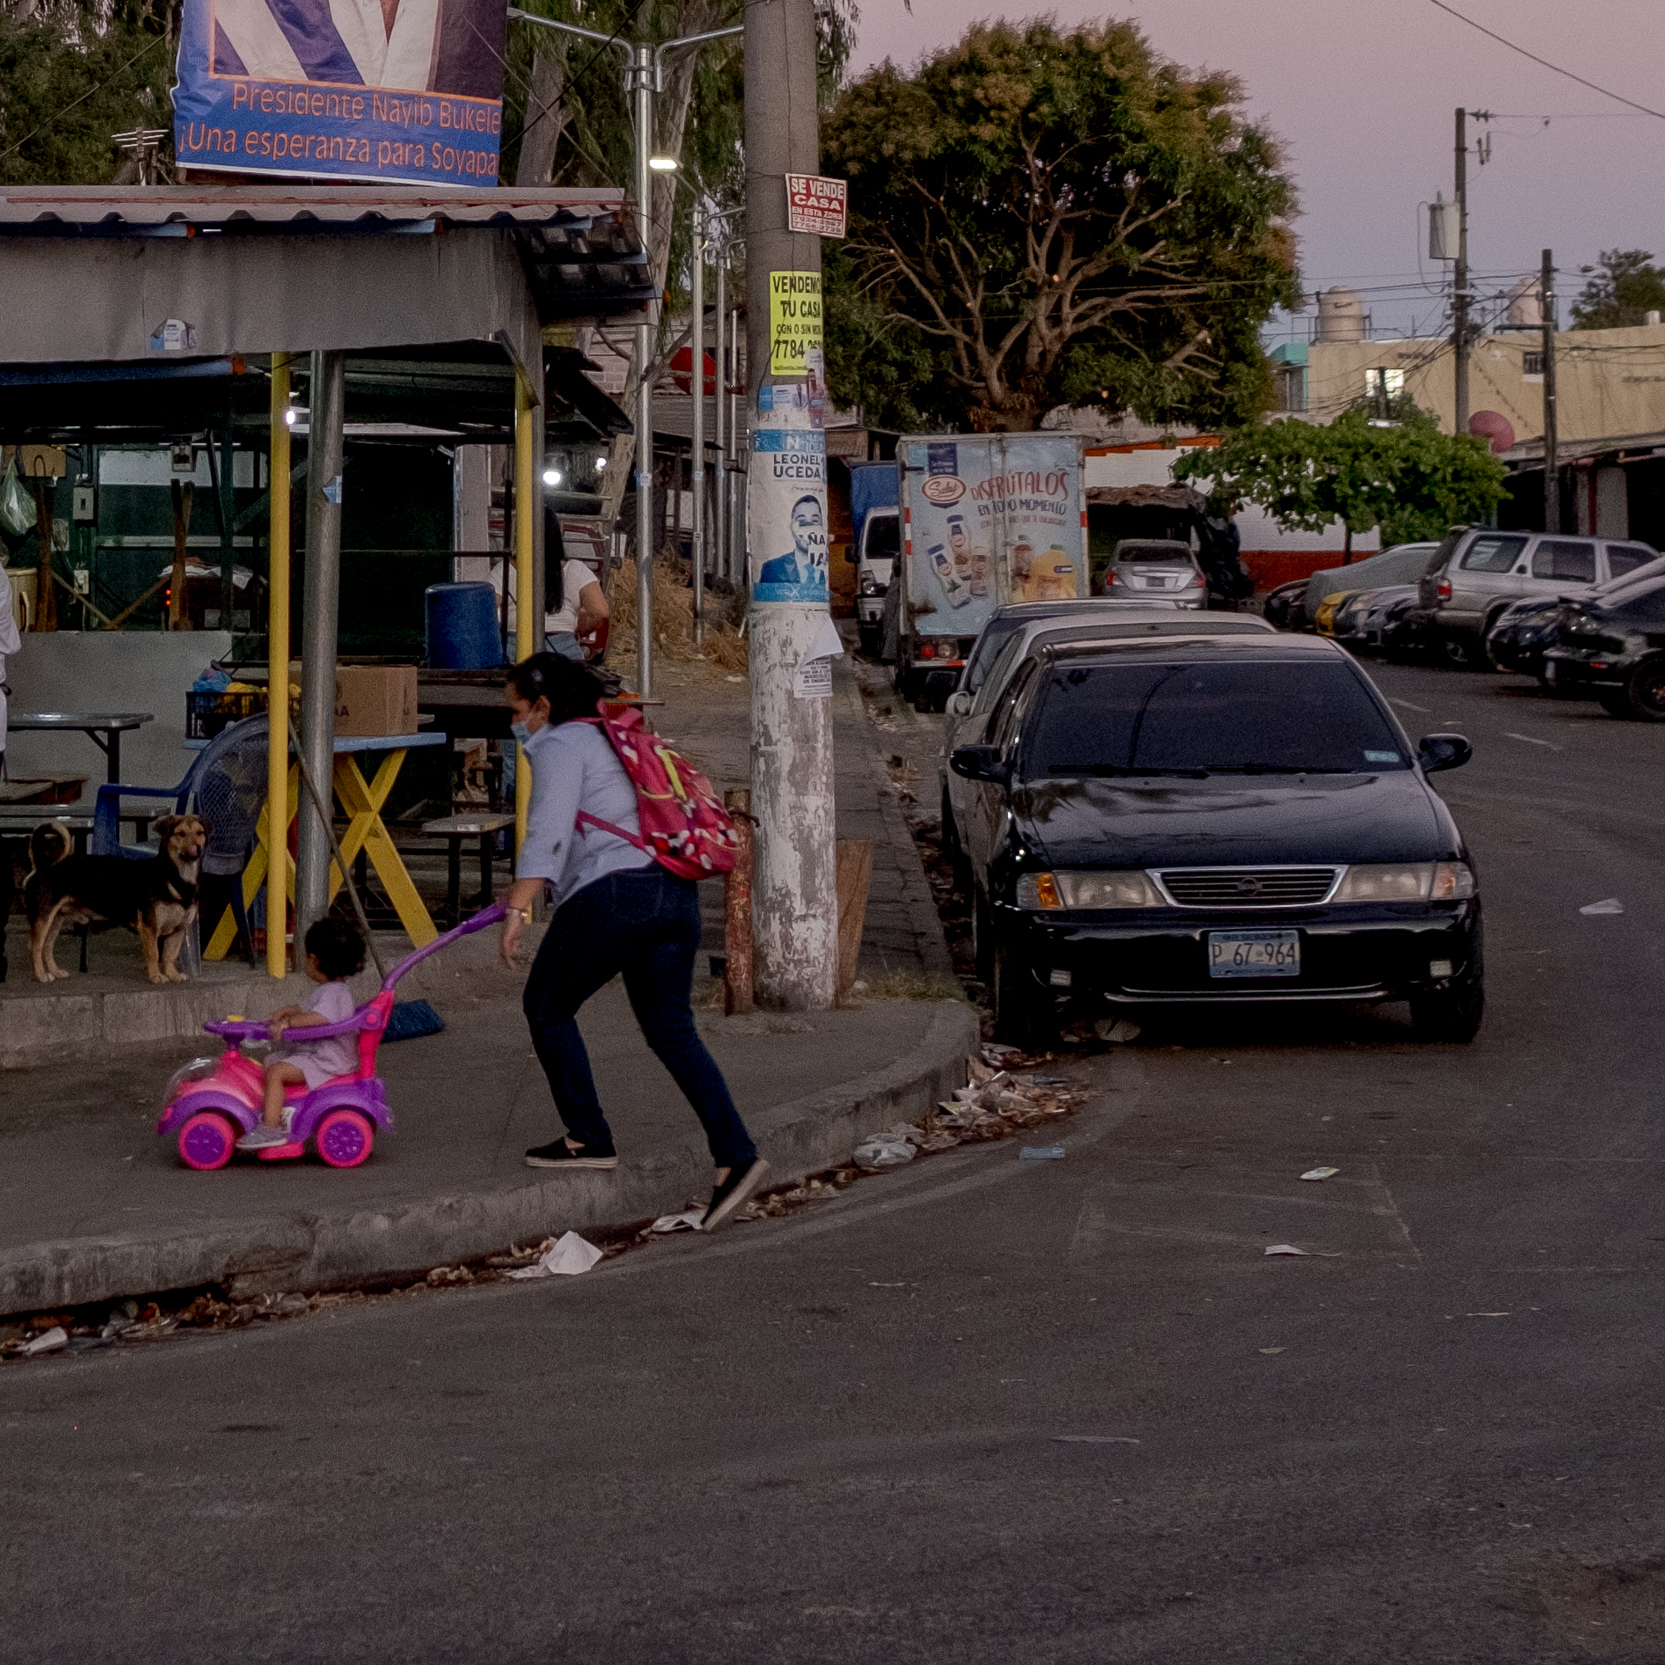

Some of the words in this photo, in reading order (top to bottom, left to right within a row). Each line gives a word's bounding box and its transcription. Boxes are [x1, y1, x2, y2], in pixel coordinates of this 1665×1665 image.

[233, 84, 364, 120] Presidente
[373, 93, 432, 128] Nayib
[439, 102, 500, 135] Bukele
[245, 130, 370, 164] esperanza
[378, 140, 424, 168] para
[791, 178, 807, 194] SE
[809, 180, 844, 200] VENDE
[794, 194, 841, 211] CASA
[780, 300, 796, 318] TU
[774, 339, 806, 359] 7784
[773, 453, 821, 466] LEONEL
[773, 466, 821, 478] UCEDA
[1020, 499, 1067, 516] MOMENTO
[1212, 943, 1222, 966] P
